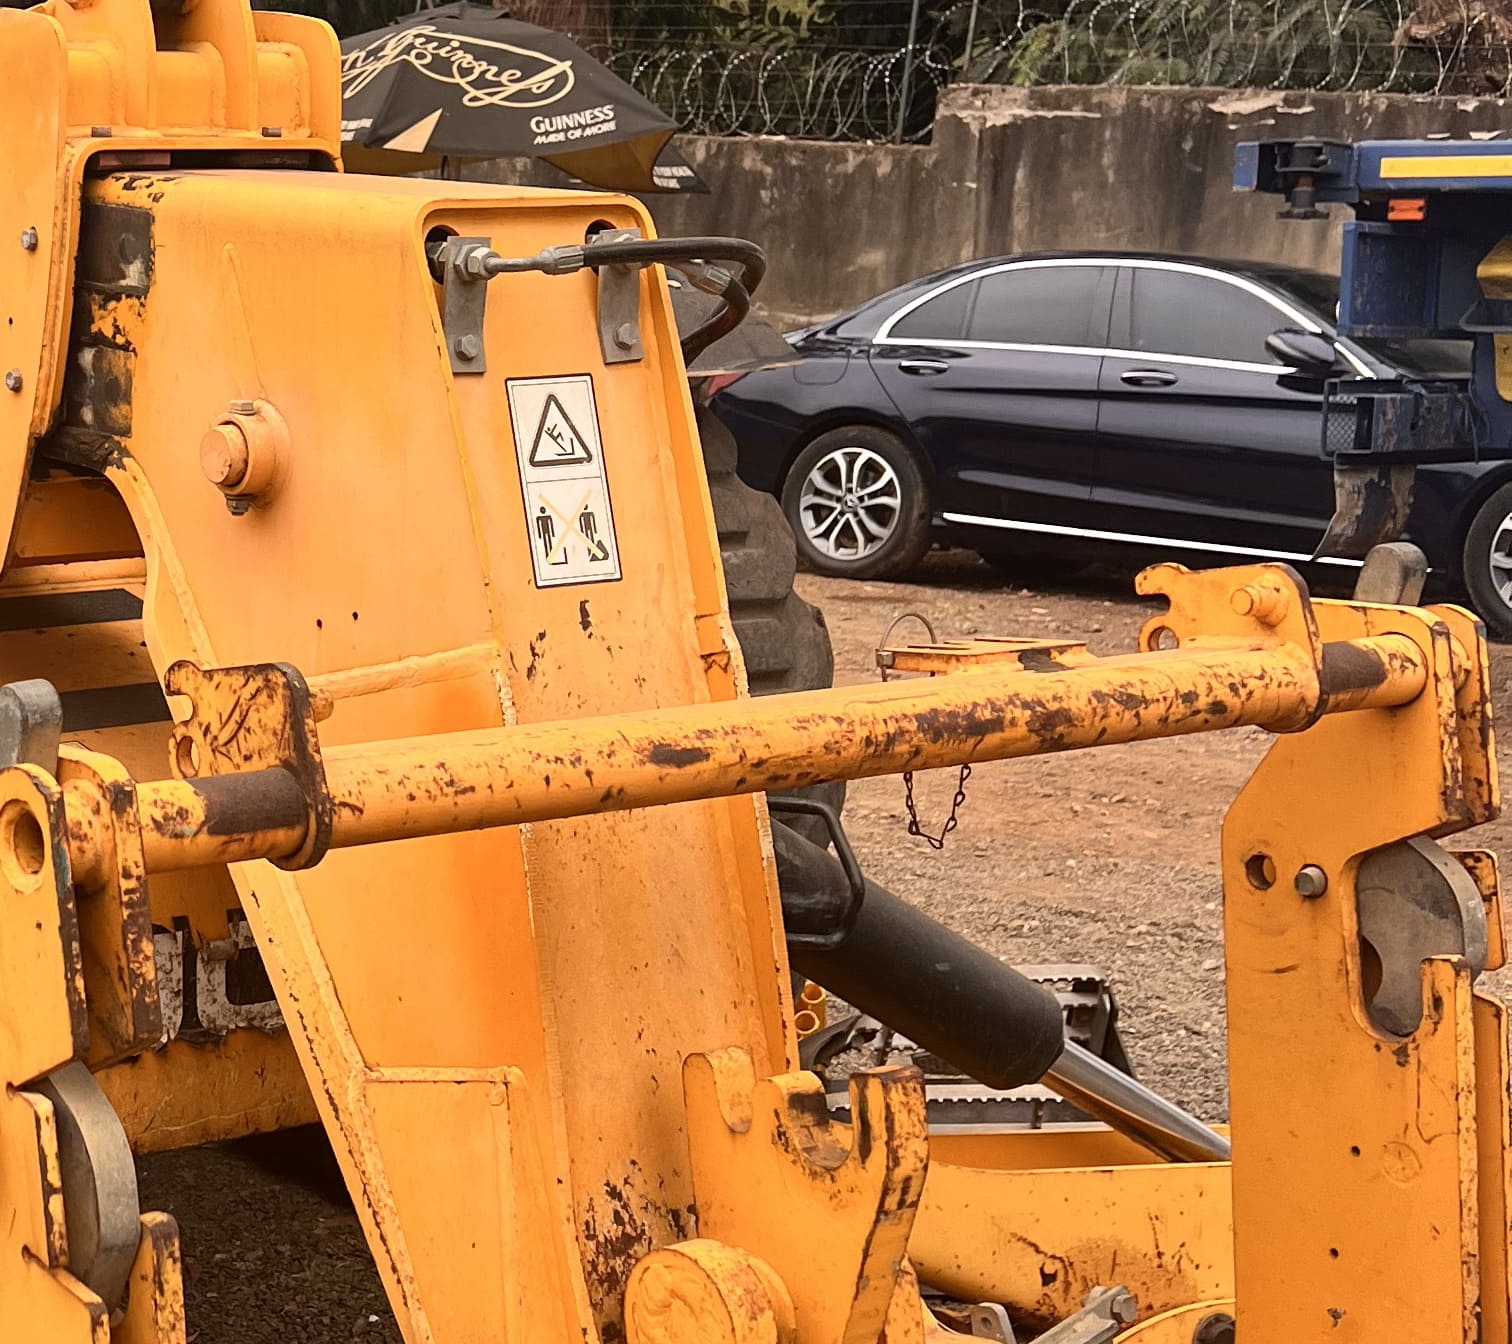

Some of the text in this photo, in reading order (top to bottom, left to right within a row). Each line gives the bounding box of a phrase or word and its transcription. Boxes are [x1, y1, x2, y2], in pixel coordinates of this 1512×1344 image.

[530, 104, 615, 134] GUINNESS
[533, 120, 617, 145] MADE OF MORE
